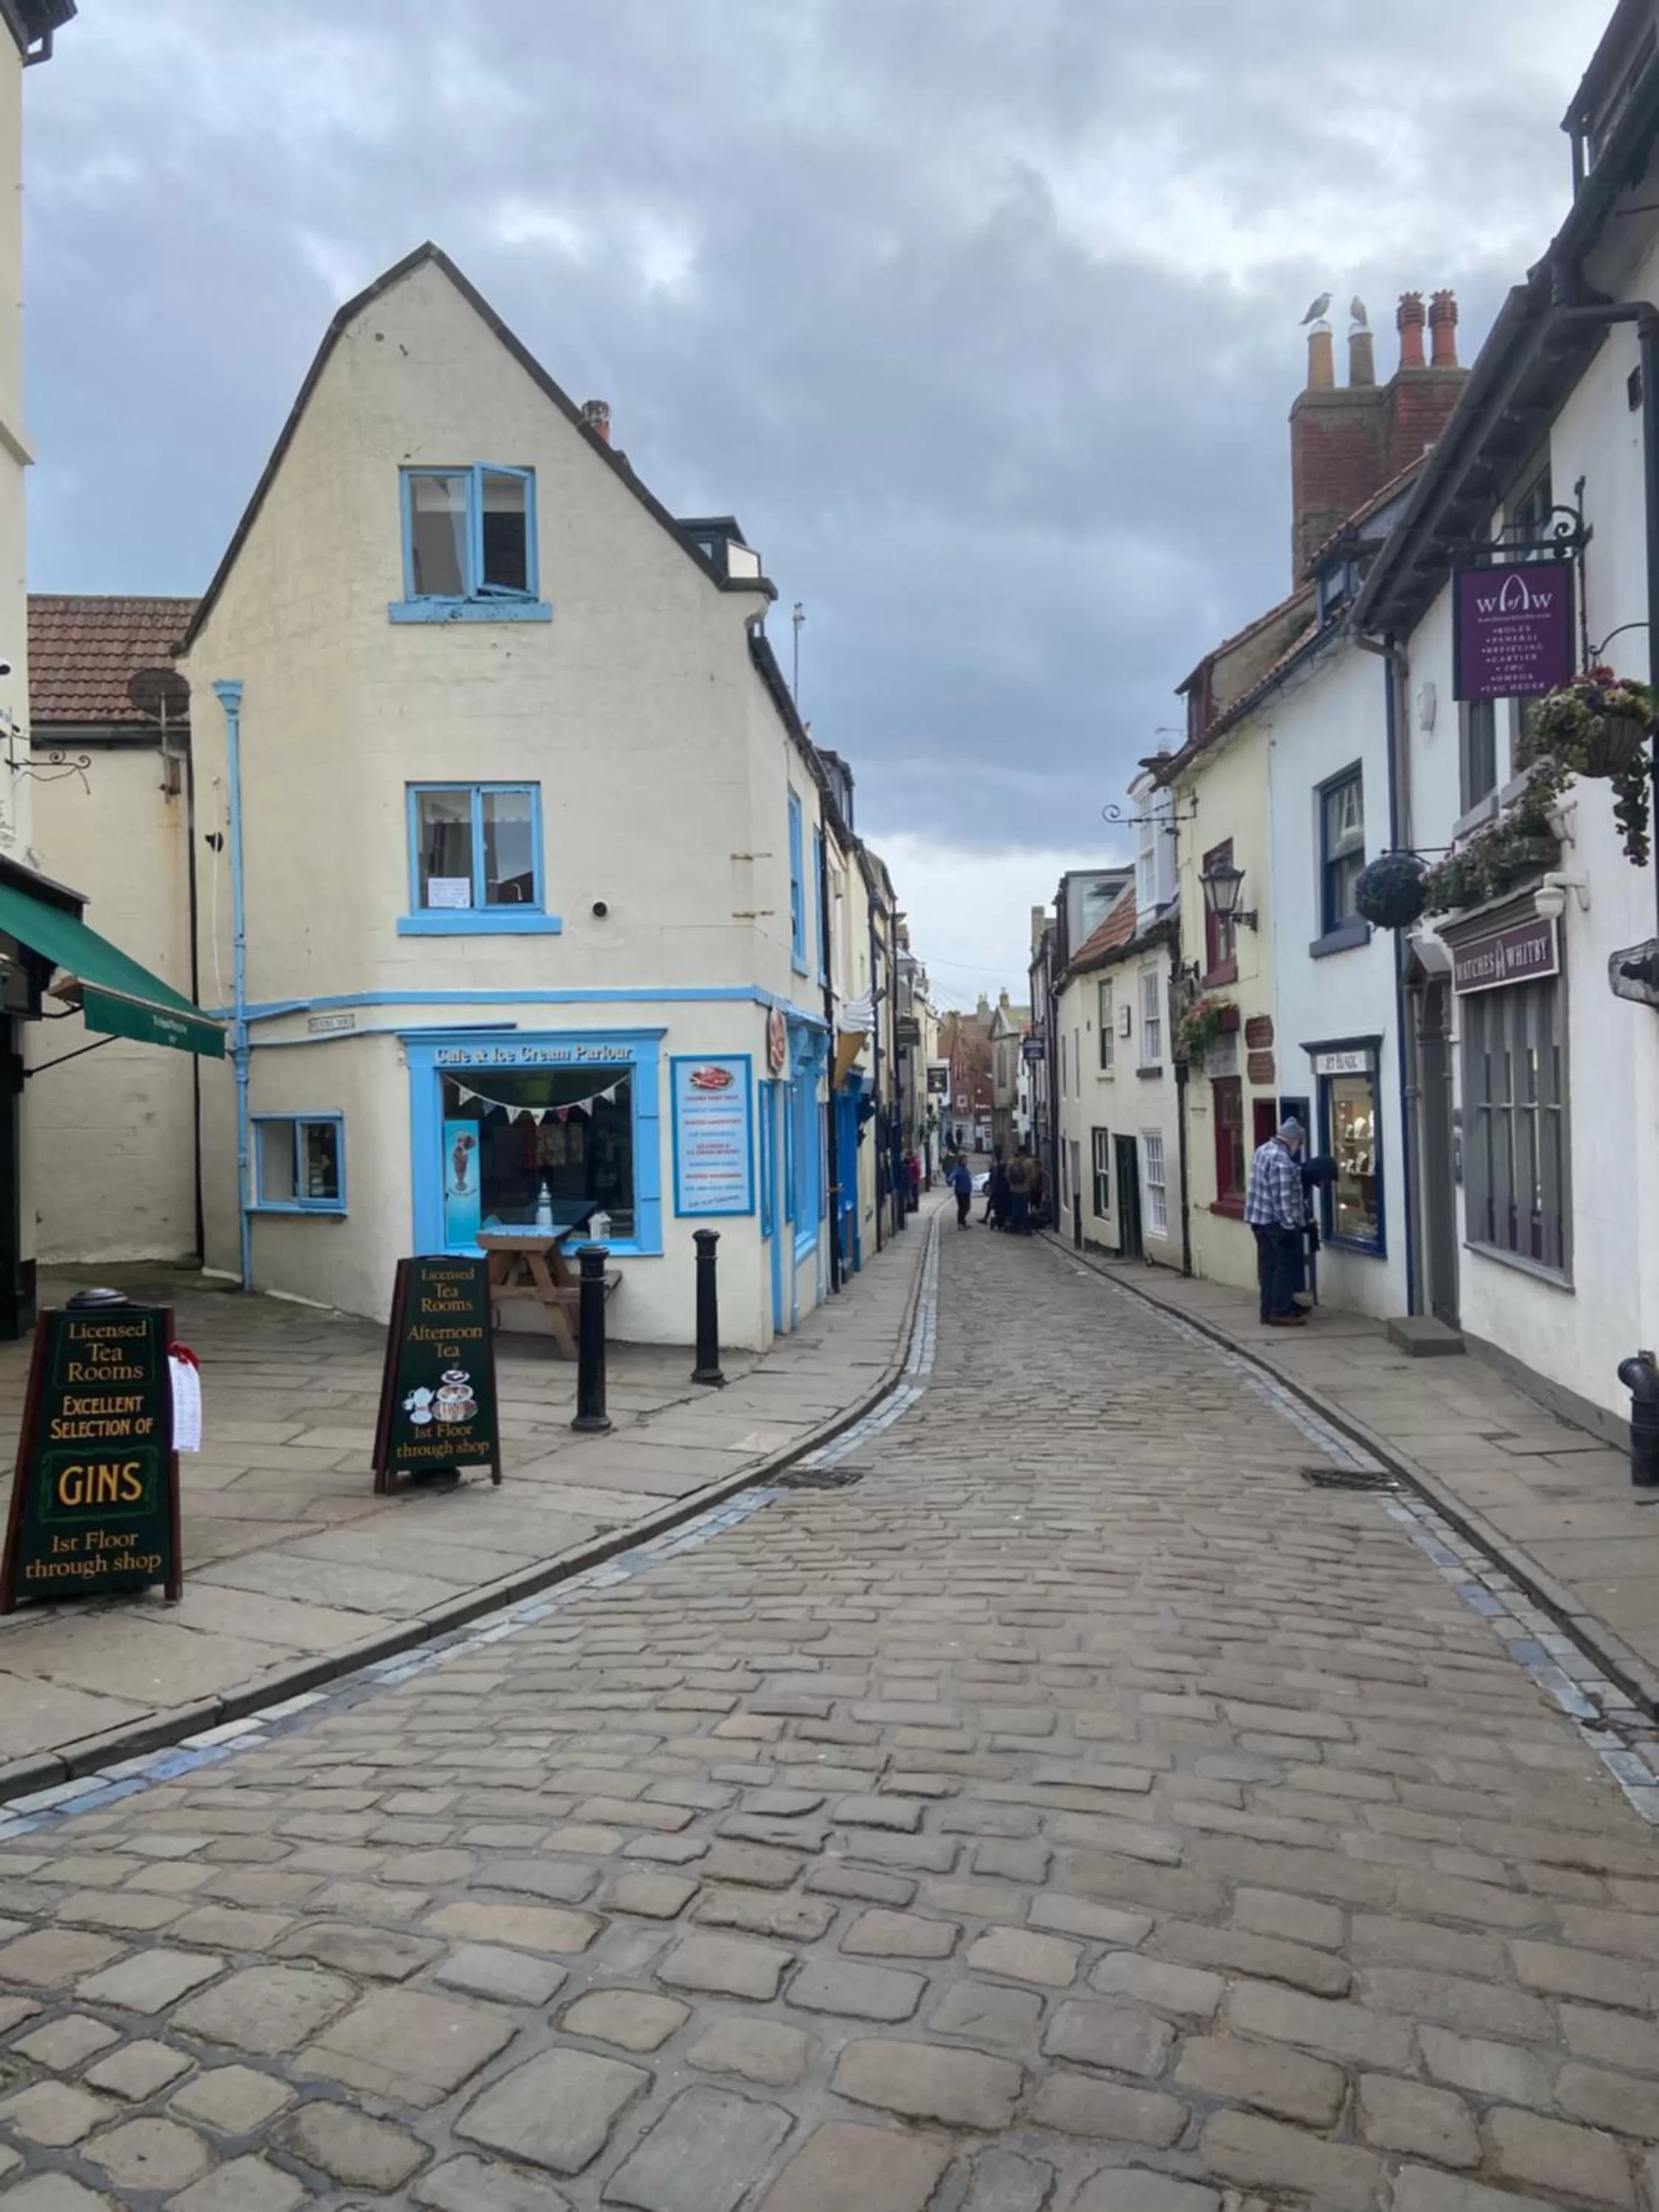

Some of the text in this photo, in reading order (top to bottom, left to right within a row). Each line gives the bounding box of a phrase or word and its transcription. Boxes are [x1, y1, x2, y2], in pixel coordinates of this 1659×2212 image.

[1506, 936, 1547, 968] WHITBY
[494, 1048, 515, 1063] Ice
[521, 1046, 571, 1063] Cream
[576, 1045, 634, 1062] Parlour
[421, 1268, 475, 1281] Licensed
[434, 1282, 459, 1298] Tea
[421, 1298, 473, 1313] Rooms
[69, 1321, 147, 1340] Licensed
[406, 1326, 483, 1340] Afternoon
[86, 1343, 123, 1362] Tea
[434, 1342, 460, 1358] Tea
[68, 1363, 144, 1382] Rooms
[63, 1396, 144, 1416] EXCELLENT
[49, 1417, 153, 1440] SELECTION OF
[437, 1422, 473, 1438] Floor
[395, 1440, 490, 1459] through shop
[58, 1461, 144, 1506] GINS
[85, 1529, 139, 1550] Floor
[26, 1551, 161, 1579] through shop
